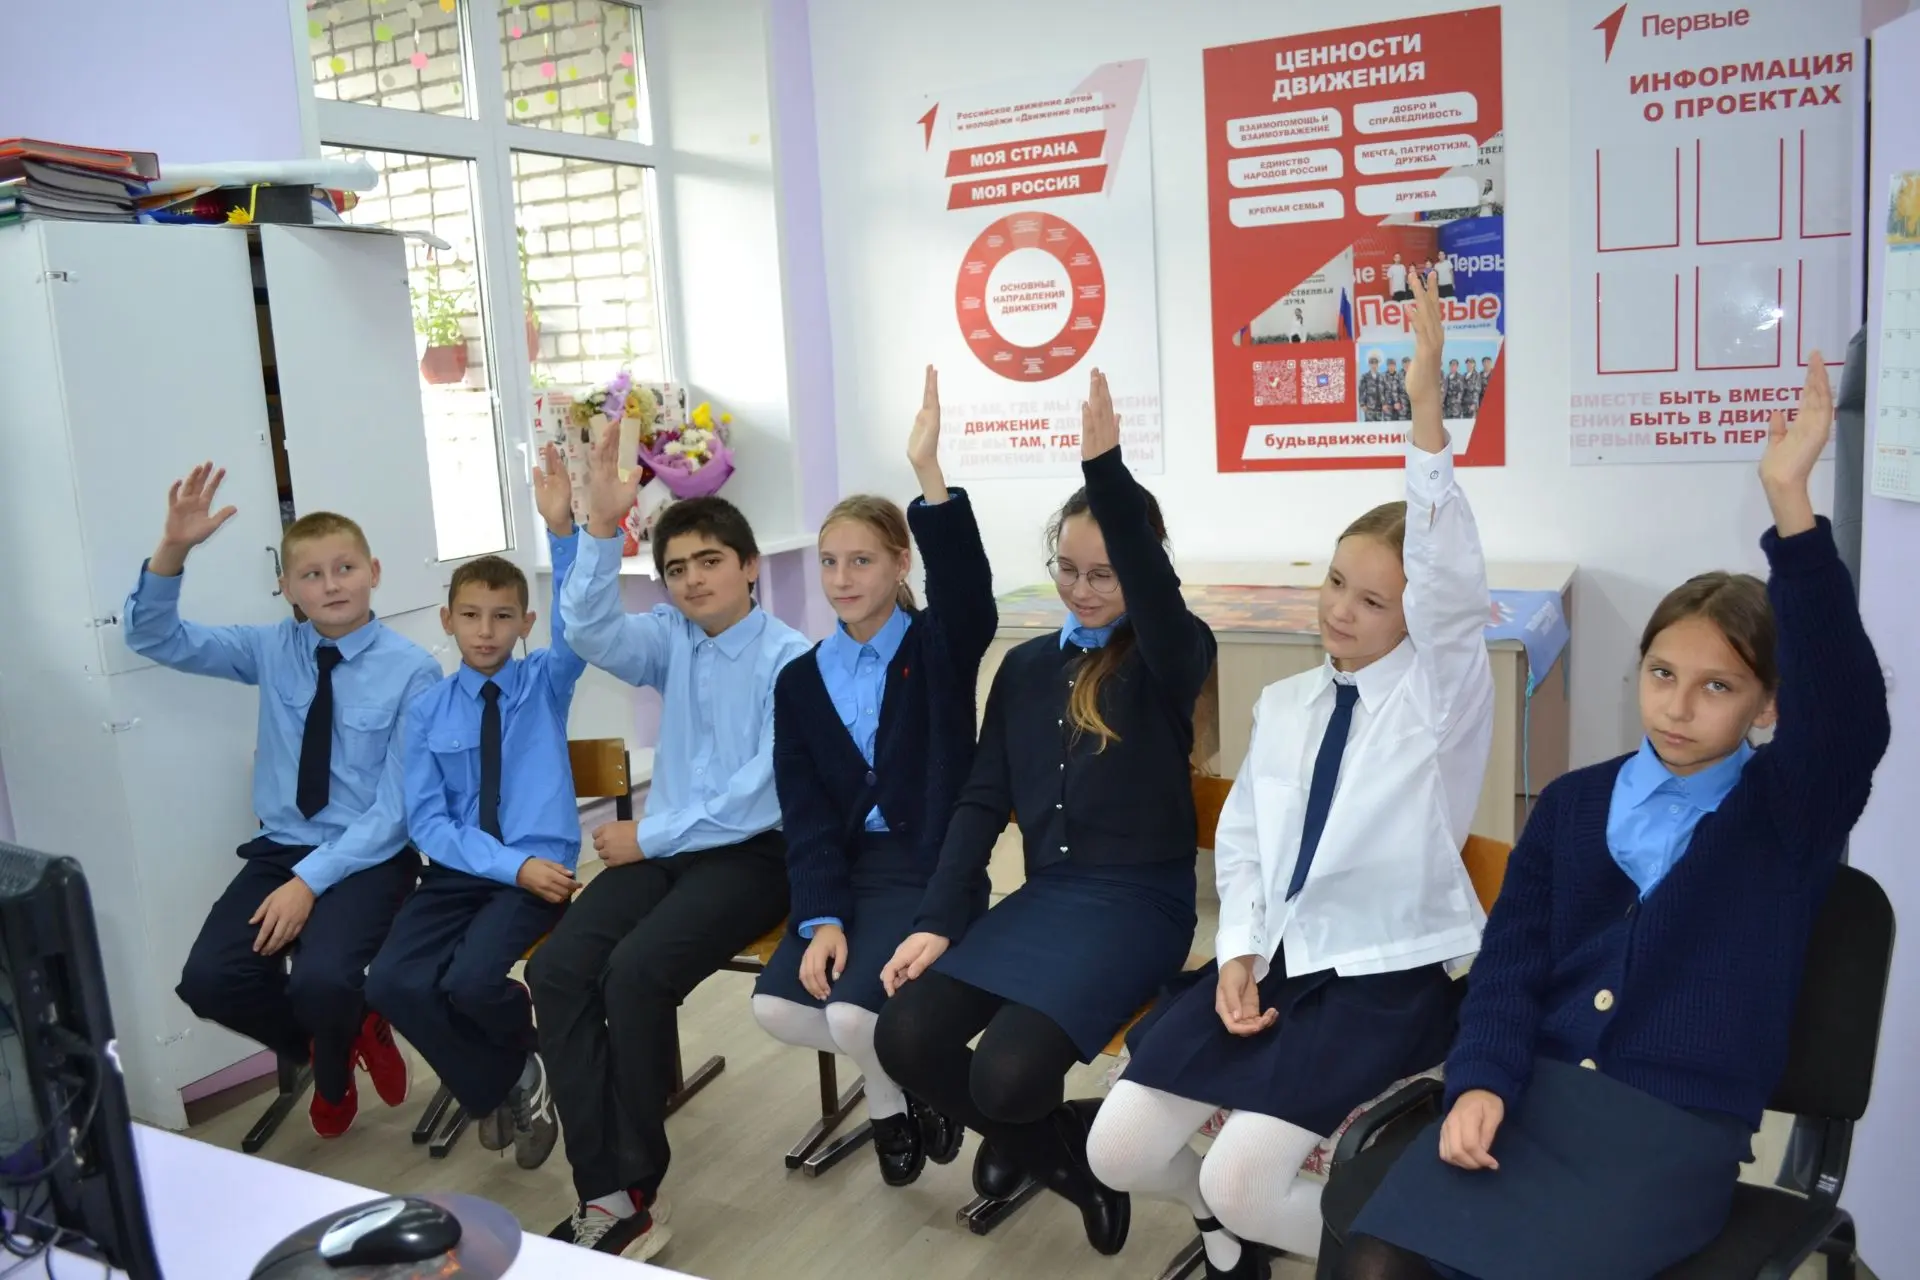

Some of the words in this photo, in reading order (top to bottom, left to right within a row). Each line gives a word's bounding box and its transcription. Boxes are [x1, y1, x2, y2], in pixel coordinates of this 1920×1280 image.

[1641, 8, 1750, 40] Первые
[1275, 33, 1422, 72] ЦЕННОСТИ
[1272, 61, 1426, 102] ДВИЖЕНИЯ
[1629, 52, 1854, 95] ИНФОРМАЦИЯ
[956, 105, 1012, 121] Российское
[1013, 99, 1063, 112] движение
[1064, 93, 1093, 106] детей
[1392, 102, 1427, 115] ДОБРО
[1429, 101, 1437, 110] И
[1643, 102, 1664, 123] О
[1674, 84, 1842, 119] ПРОЕКТАХ
[1015, 109, 1071, 124] «Движение
[1073, 102, 1117, 116] первых»
[1369, 109, 1462, 126] СПРАВЕДЛИВОСТЬ
[1239, 116, 1319, 133] ВЗАИМОПОМОЩЬ
[1320, 114, 1329, 123] И
[1240, 124, 1330, 142] ВЗАИМОУВАЖЕНИЕ
[970, 151, 1006, 168] МОЯ
[1010, 140, 1078, 162] СТРАНА
[1362, 147, 1398, 159] МЕЧТА,
[1400, 141, 1471, 155] ПАТРИОТИЗМ,
[1260, 156, 1311, 170] ЕДИНСТВО
[1395, 154, 1437, 166] ДРУЖБА
[1243, 167, 1287, 180] НАРОДОВ
[1289, 165, 1328, 176] РОССИИ
[971, 185, 1007, 201] МОЯ
[1012, 174, 1081, 196] РОССИЯ
[1395, 190, 1437, 202] ДРУЖБА
[1249, 204, 1290, 216] КРЕПКАЯ
[1292, 201, 1325, 212] СЕМЬЯ
[1000, 280, 1056, 292] ОСНОВНЫЕ
[993, 290, 1066, 304] НАПРАВЛЕНИЯ
[1002, 302, 1058, 315] ДВИЖЕНИЯ
[1570, 392, 1654, 408] ВМЕСТЕ
[1659, 388, 1721, 405] БЫТЬ
[1728, 387, 1804, 403] ВМЕСТ
[964, 418, 1050, 436] ДВИЖЕНИЕ
[1630, 411, 1691, 426] БЫТЬ
[1698, 410, 1712, 425] В
[1009, 436, 1046, 450] ТАМ,
[1050, 433, 1080, 449] ГДЕ
[1264, 433, 1406, 449] будьвдвижени
[1570, 432, 1651, 448] ЕРВЫМ
[1655, 430, 1717, 446] БЫТЬ
